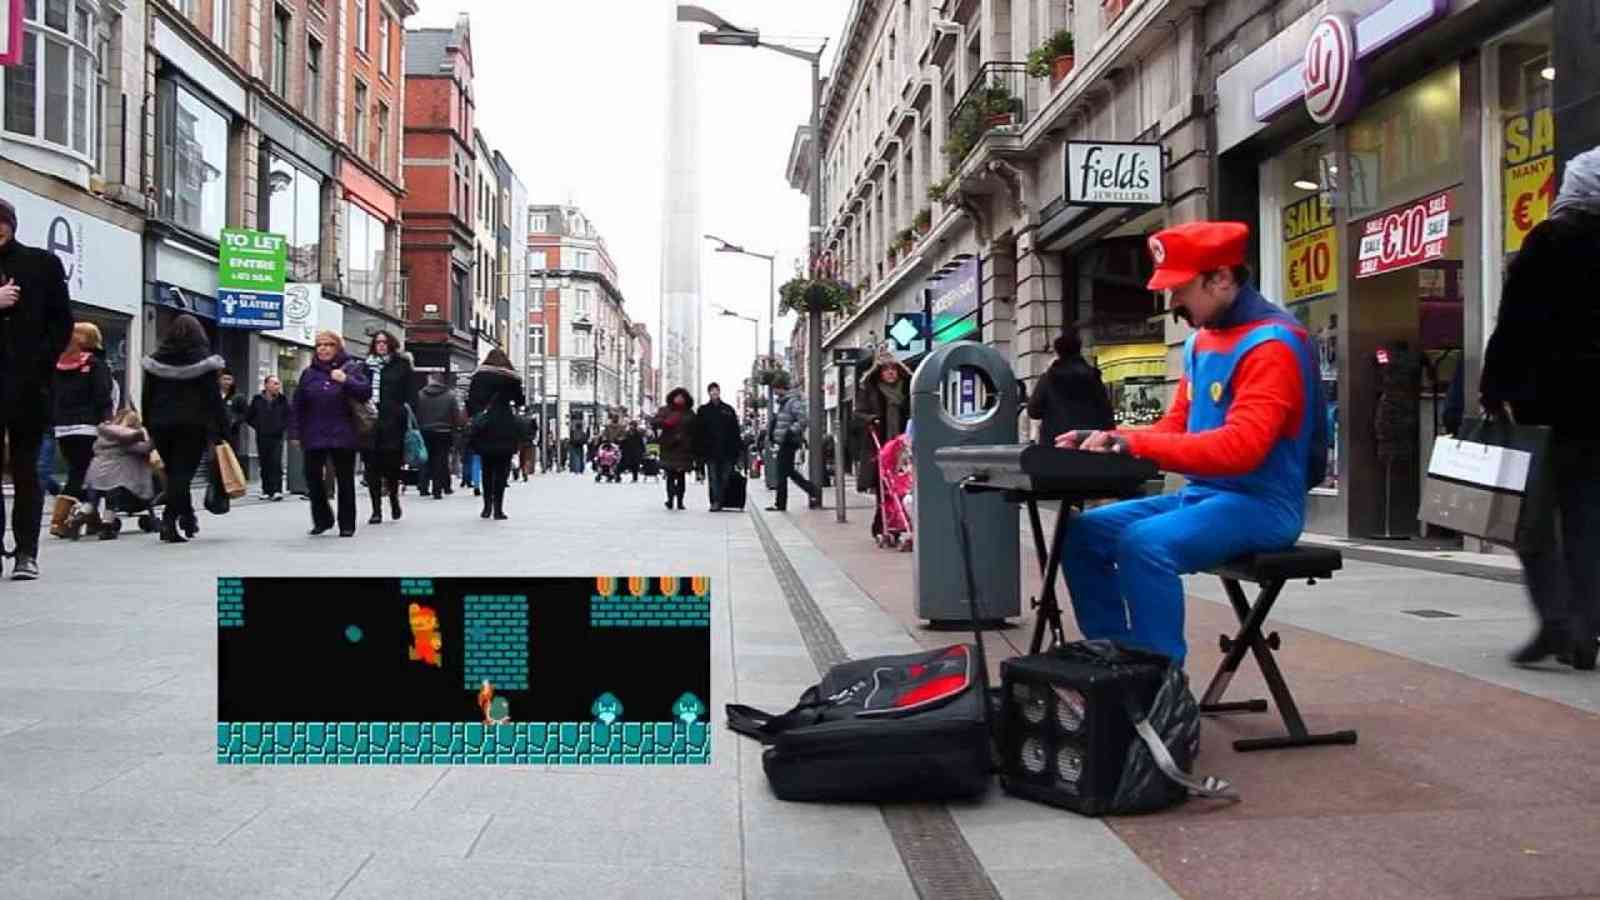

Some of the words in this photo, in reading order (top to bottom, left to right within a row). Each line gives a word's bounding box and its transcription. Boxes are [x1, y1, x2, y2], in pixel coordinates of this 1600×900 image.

[1512, 160, 1548, 180] MANY
[1285, 191, 1334, 240] SALE
[1381, 205, 1427, 263] €10
[1427, 217, 1445, 235] SALE
[224, 233, 248, 246] TO
[254, 236, 282, 249] LET
[1363, 239, 1382, 254] SALE
[229, 258, 275, 270] ENTIRE
[1289, 242, 1331, 288] €10
